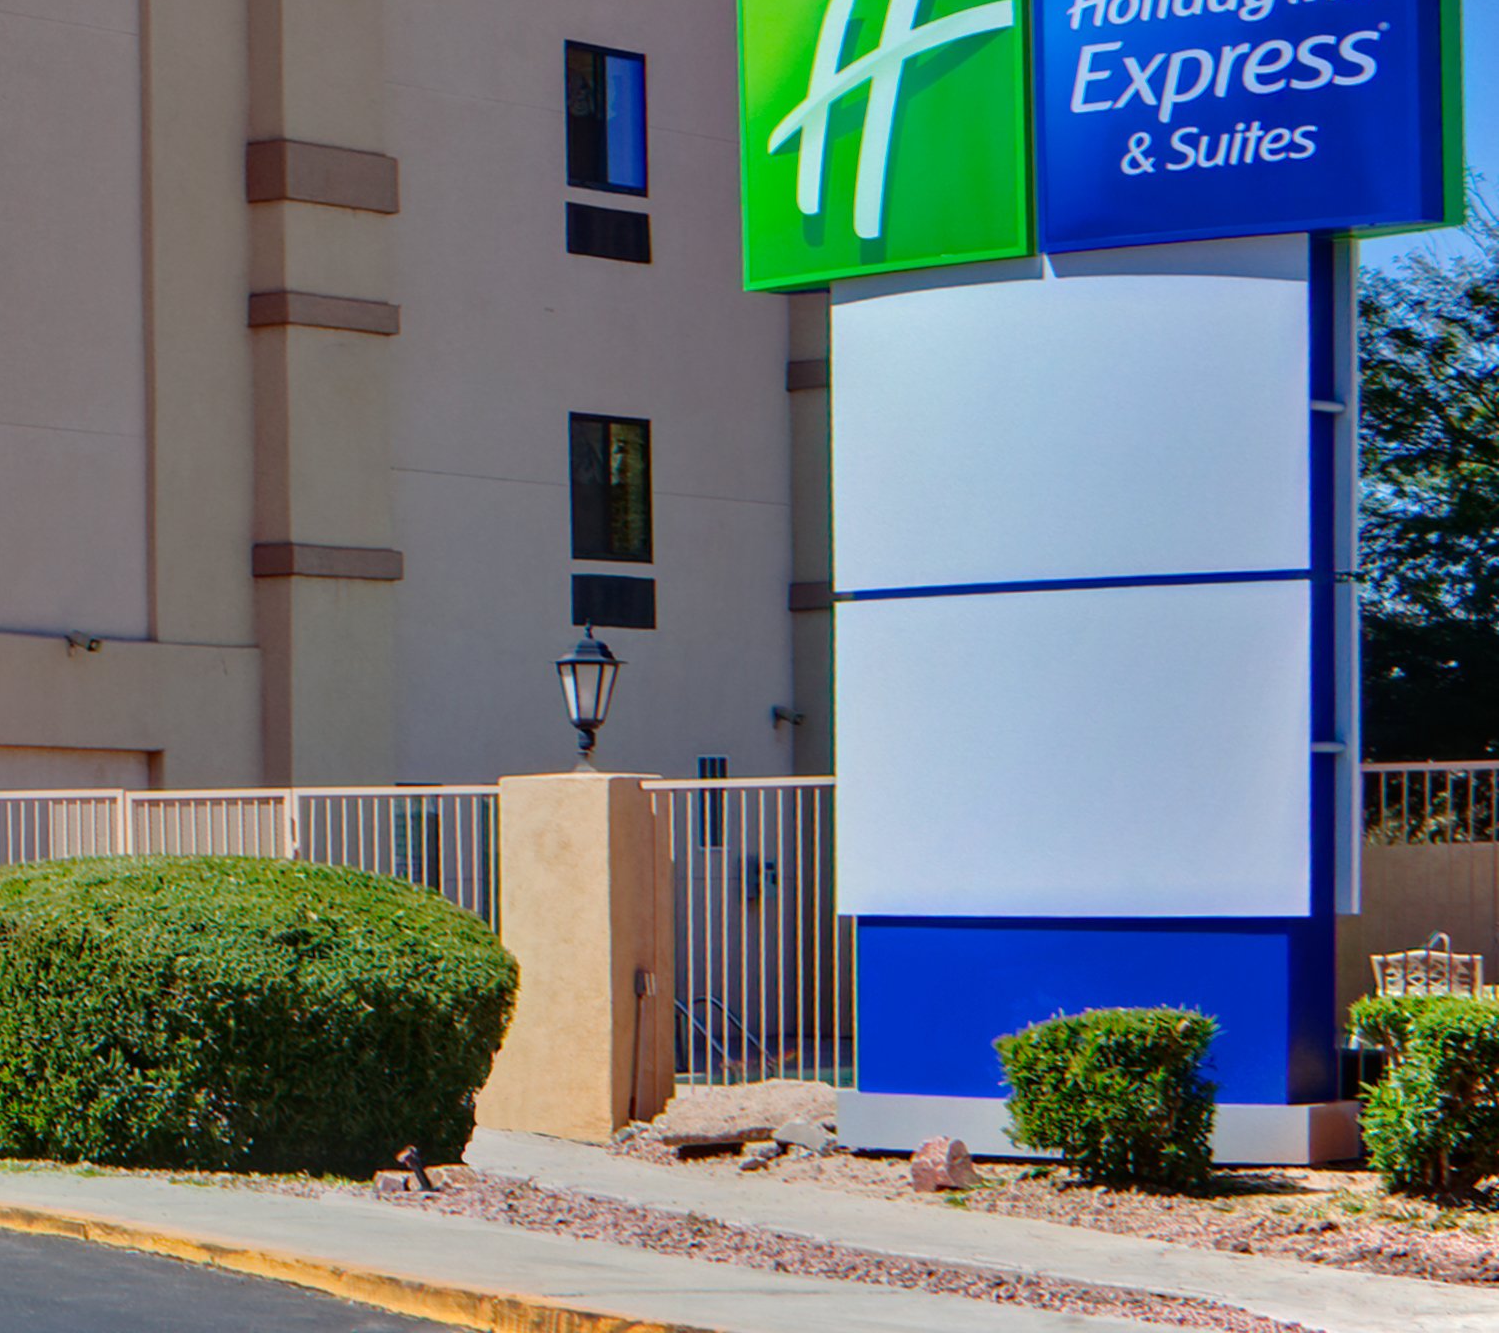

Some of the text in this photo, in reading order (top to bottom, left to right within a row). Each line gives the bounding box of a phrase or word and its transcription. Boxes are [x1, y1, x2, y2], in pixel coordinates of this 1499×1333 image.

[1070, 30, 1382, 123] Express
[1120, 121, 1319, 176] & Suites
